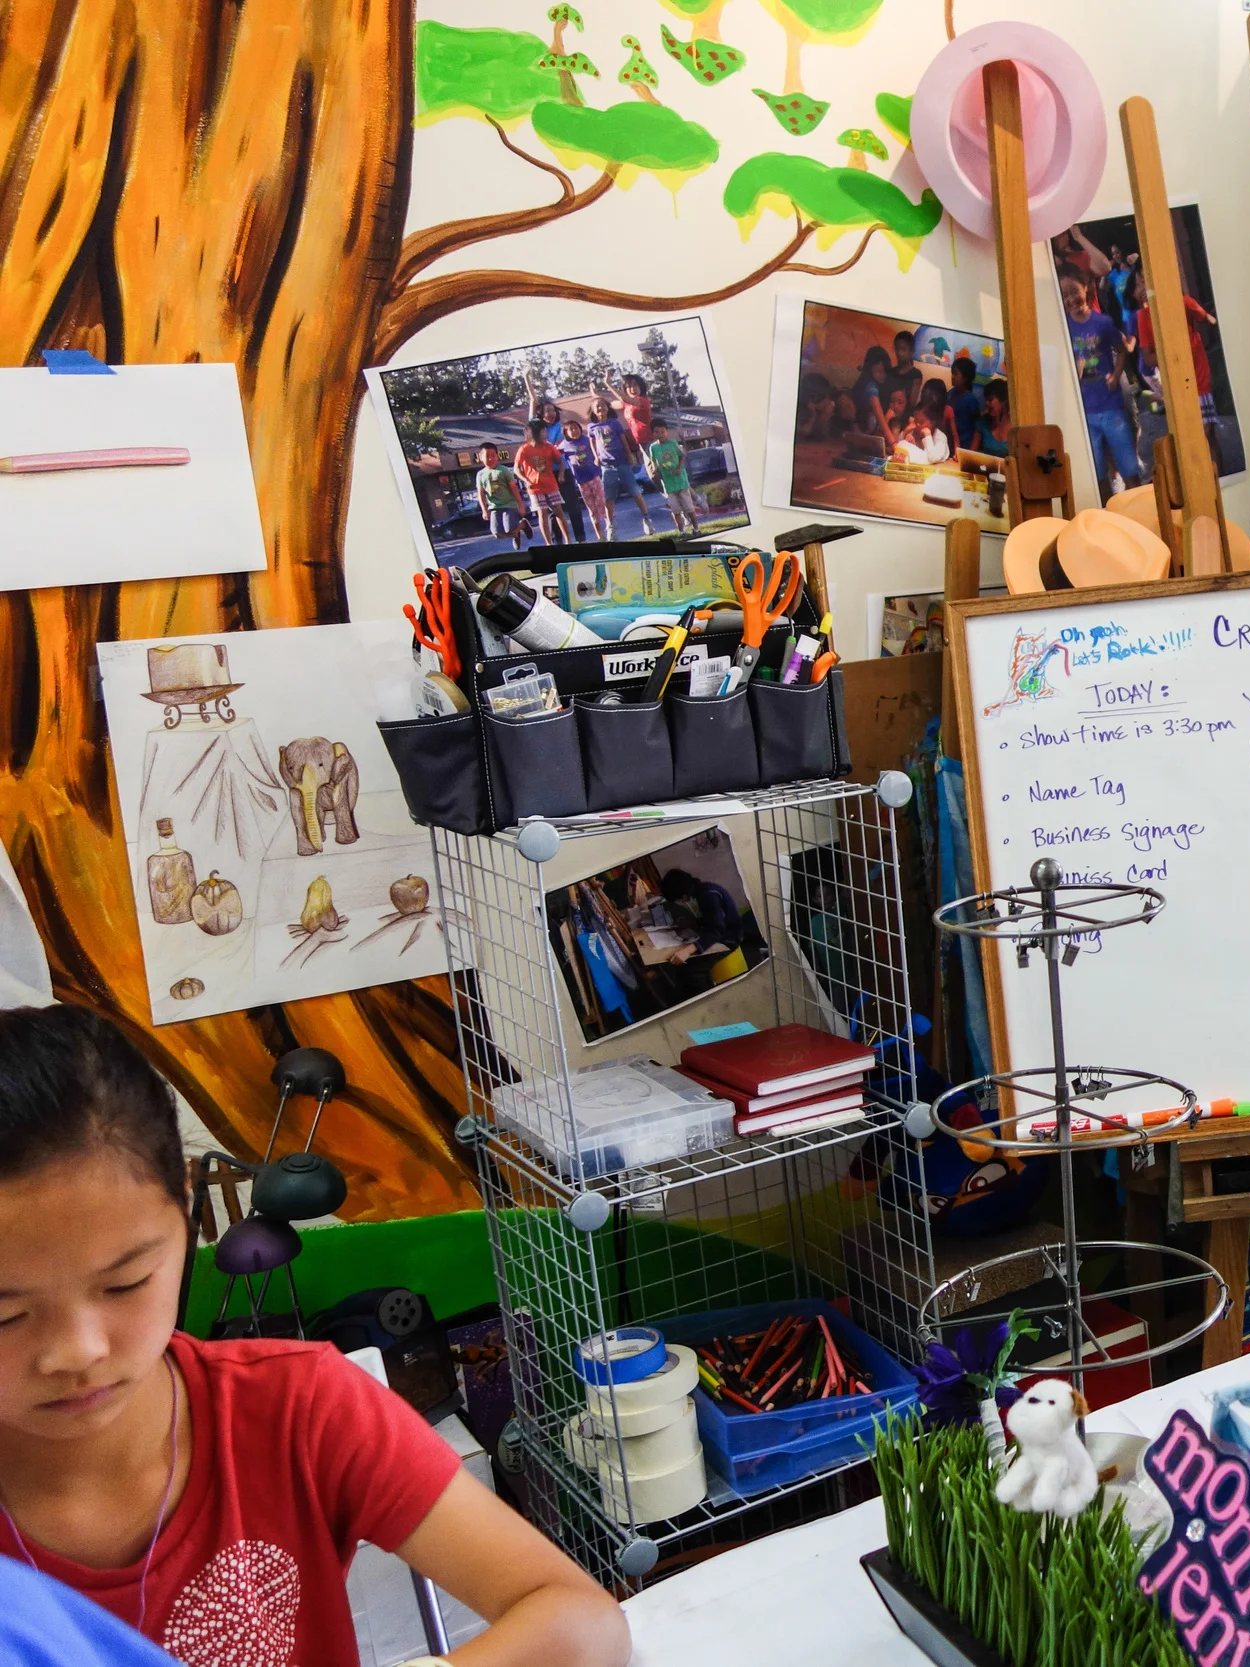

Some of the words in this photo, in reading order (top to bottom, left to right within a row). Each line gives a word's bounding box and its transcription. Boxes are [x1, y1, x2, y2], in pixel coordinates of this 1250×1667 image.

[708, 558, 723, 589] Splash
[608, 654, 700, 676] Workce
[1029, 780, 1087, 802] Name
[1090, 774, 1126, 806] Tag
[1032, 826, 1111, 848] Business
[1121, 819, 1205, 852] Signage
[1127, 859, 1167, 882] Card
